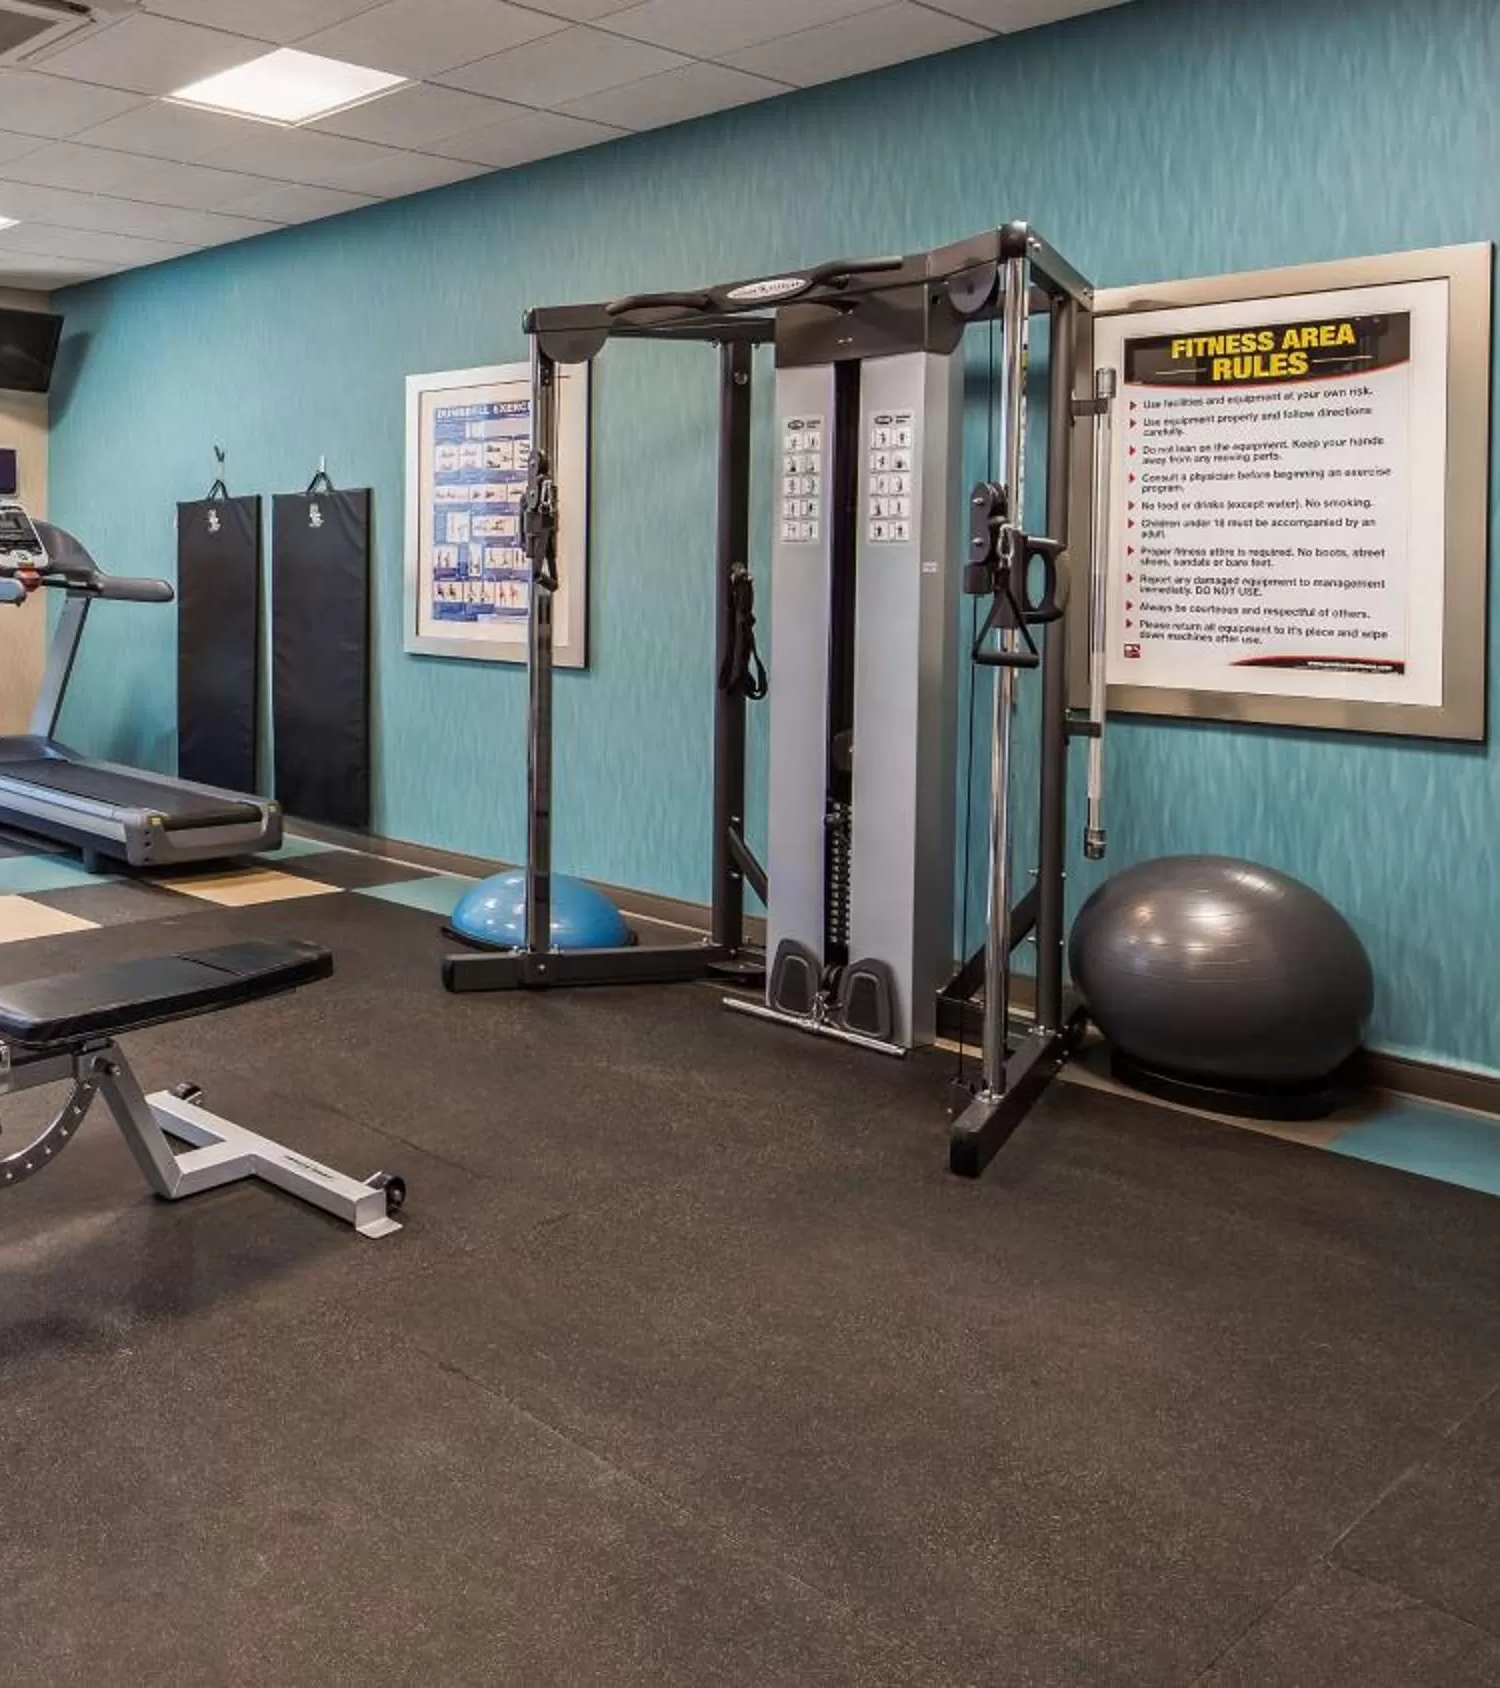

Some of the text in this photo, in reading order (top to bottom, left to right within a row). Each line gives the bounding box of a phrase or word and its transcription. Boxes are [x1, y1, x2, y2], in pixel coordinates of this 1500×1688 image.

[1171, 323, 1356, 359] FITNESS AREA
[1211, 351, 1310, 381] RULES
[1143, 399, 1161, 408] Use
[1206, 396, 1225, 405] and
[1227, 392, 1281, 404] equipment
[1297, 390, 1321, 401] your
[1323, 388, 1347, 398] own
[1349, 385, 1373, 396] risk.
[1143, 406, 1373, 427] Use equipment properly and follow directions
[1142, 445, 1156, 454] Do
[1158, 444, 1174, 453] not
[1175, 444, 1197, 453] lean
[1199, 444, 1211, 453] on
[1213, 442, 1230, 451] the
[1292, 438, 1320, 448] Keep
[1321, 438, 1347, 449] your
[1349, 435, 1385, 446] hands
[1142, 451, 1282, 466] away from any moving parts.
[1141, 472, 1179, 482] Consult
[1189, 470, 1235, 482] physician
[1237, 469, 1271, 479] before
[1273, 469, 1325, 481] beginning
[1327, 468, 1342, 477] an
[1343, 467, 1392, 477] exercise
[1141, 484, 1184, 495] program.
[1141, 501, 1155, 510] No
[1157, 501, 1179, 510] food
[1181, 501, 1192, 510] or
[1193, 500, 1225, 509] drinks
[1227, 500, 1265, 510] (except
[1305, 498, 1321, 508] No
[1323, 498, 1373, 509] smoking.
[1141, 519, 1181, 528] Children
[1182, 518, 1211, 528] under
[1227, 518, 1253, 527] must
[1255, 518, 1269, 527] be
[1271, 517, 1343, 529] accompanied
[1345, 517, 1359, 529] by
[1361, 519, 1376, 527] an
[1140, 546, 1172, 557] Proper
[1173, 547, 1207, 557] fitness
[1209, 547, 1235, 557] attire
[1237, 547, 1247, 557] is
[1248, 547, 1295, 558] required.
[1297, 547, 1313, 557] No
[1351, 547, 1386, 558] street
[1173, 557, 1211, 567] sandals
[1213, 559, 1224, 567] or
[1225, 557, 1249, 567] bare
[1139, 574, 1386, 590] Report any damaged equipment to management
[1195, 585, 1211, 595] DO
[1213, 586, 1235, 596] NOT
[1237, 586, 1263, 597] USE.
[1139, 601, 1371, 619] Always be courteous and respectful of others.
[1139, 619, 1171, 629] Please
[1171, 621, 1202, 631] return
[1218, 624, 1271, 635] equipment
[1273, 625, 1285, 635] to
[1287, 625, 1303, 636] it's
[1305, 627, 1335, 638] place
[1337, 628, 1359, 638] and
[1361, 629, 1389, 640] wipe
[1139, 631, 1165, 640] down
[1167, 631, 1213, 643] machines
[1215, 633, 1239, 643] after
